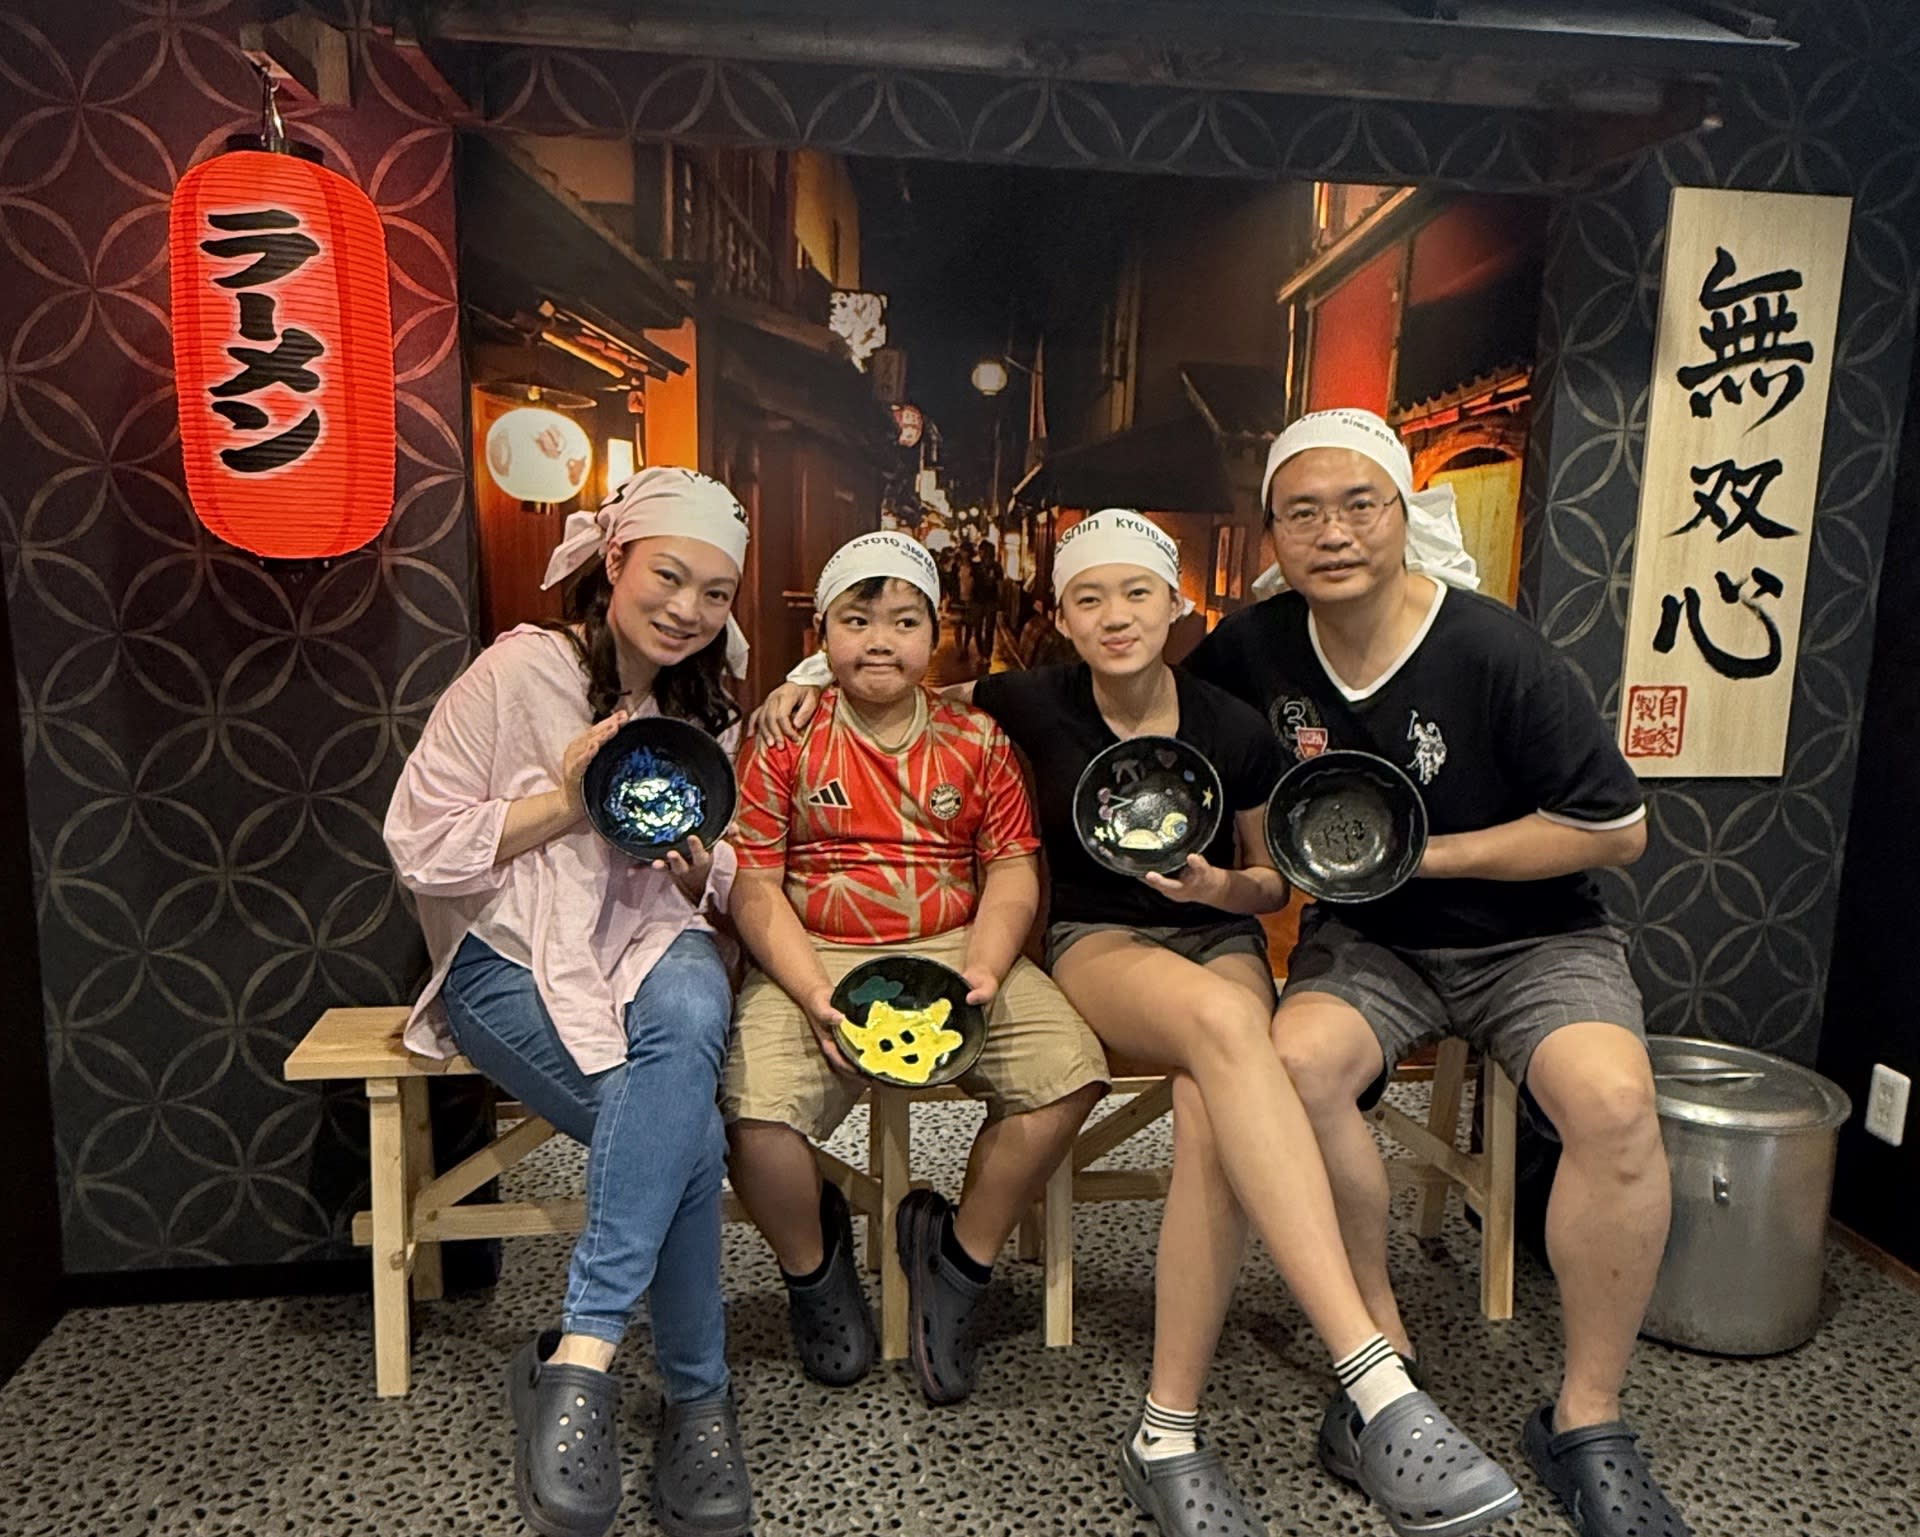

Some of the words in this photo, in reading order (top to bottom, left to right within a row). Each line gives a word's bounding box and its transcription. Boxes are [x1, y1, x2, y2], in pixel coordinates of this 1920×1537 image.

[200, 209, 325, 473] ラーメン
[1115, 517, 1159, 542] KYOTO
[1652, 246, 1814, 680] 無双心
[852, 537, 900, 549] KYOTO
